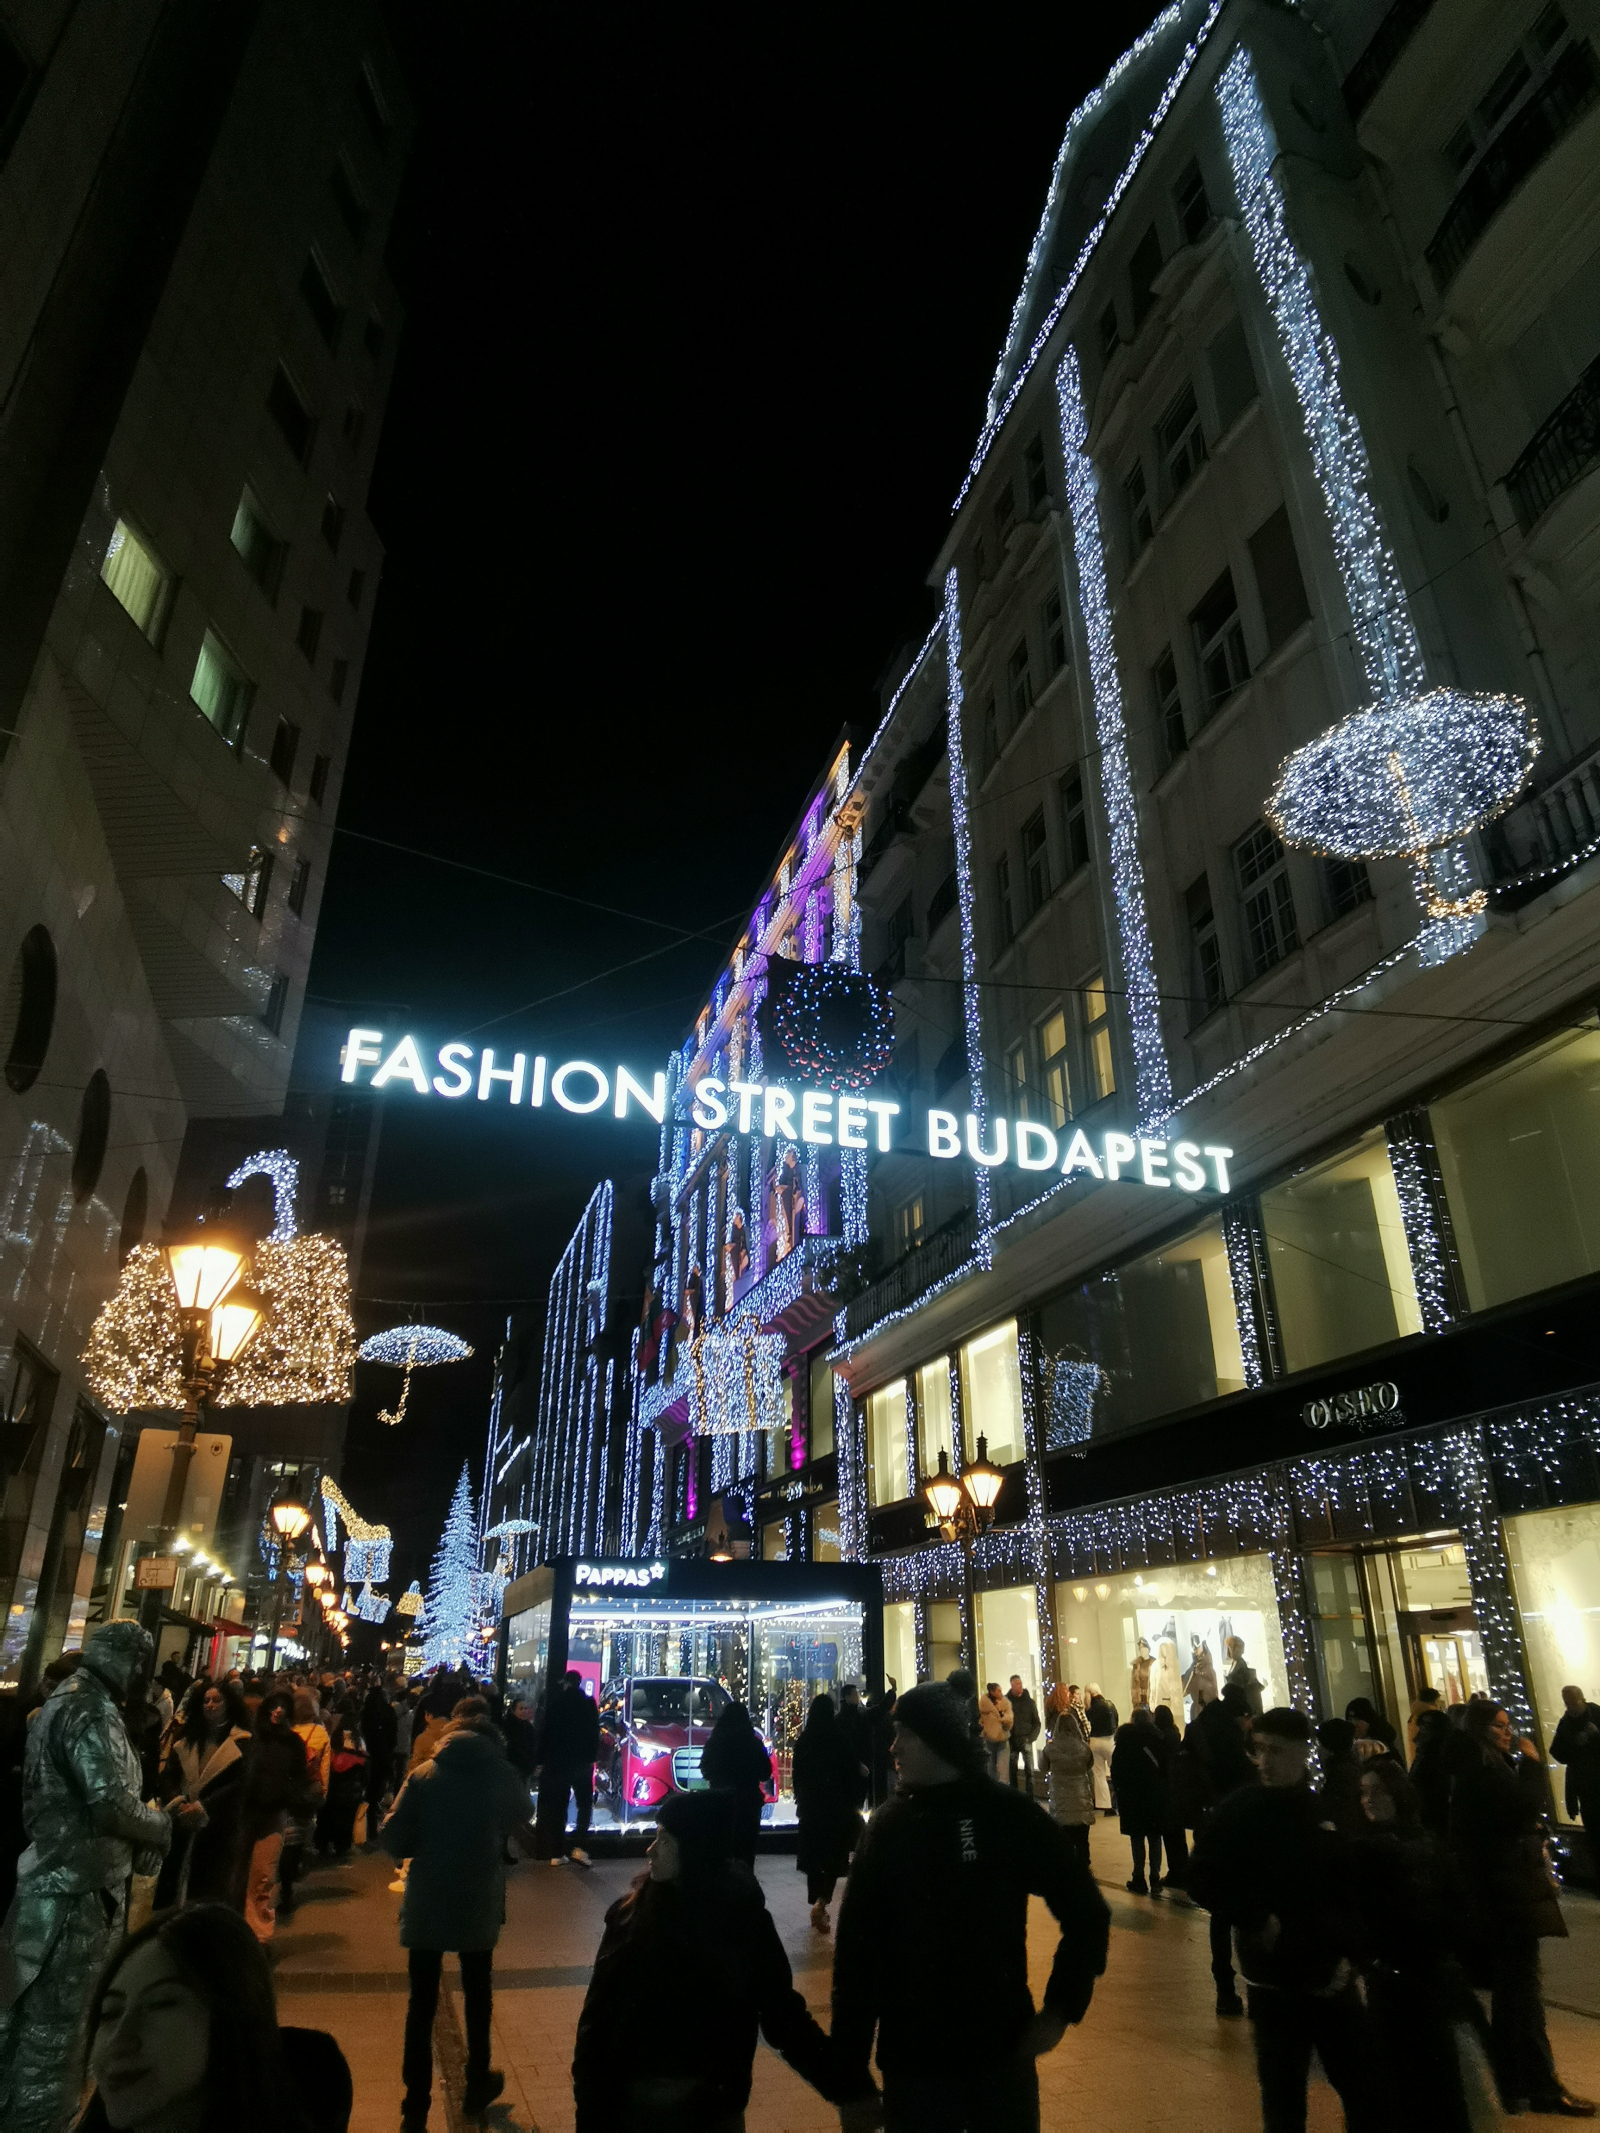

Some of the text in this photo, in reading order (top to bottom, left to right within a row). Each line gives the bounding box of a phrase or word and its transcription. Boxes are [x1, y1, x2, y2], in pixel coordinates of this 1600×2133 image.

[341, 1028, 1234, 1194] FASHION STREET BUDAPEST
[959, 1818, 978, 1862] NIKE
